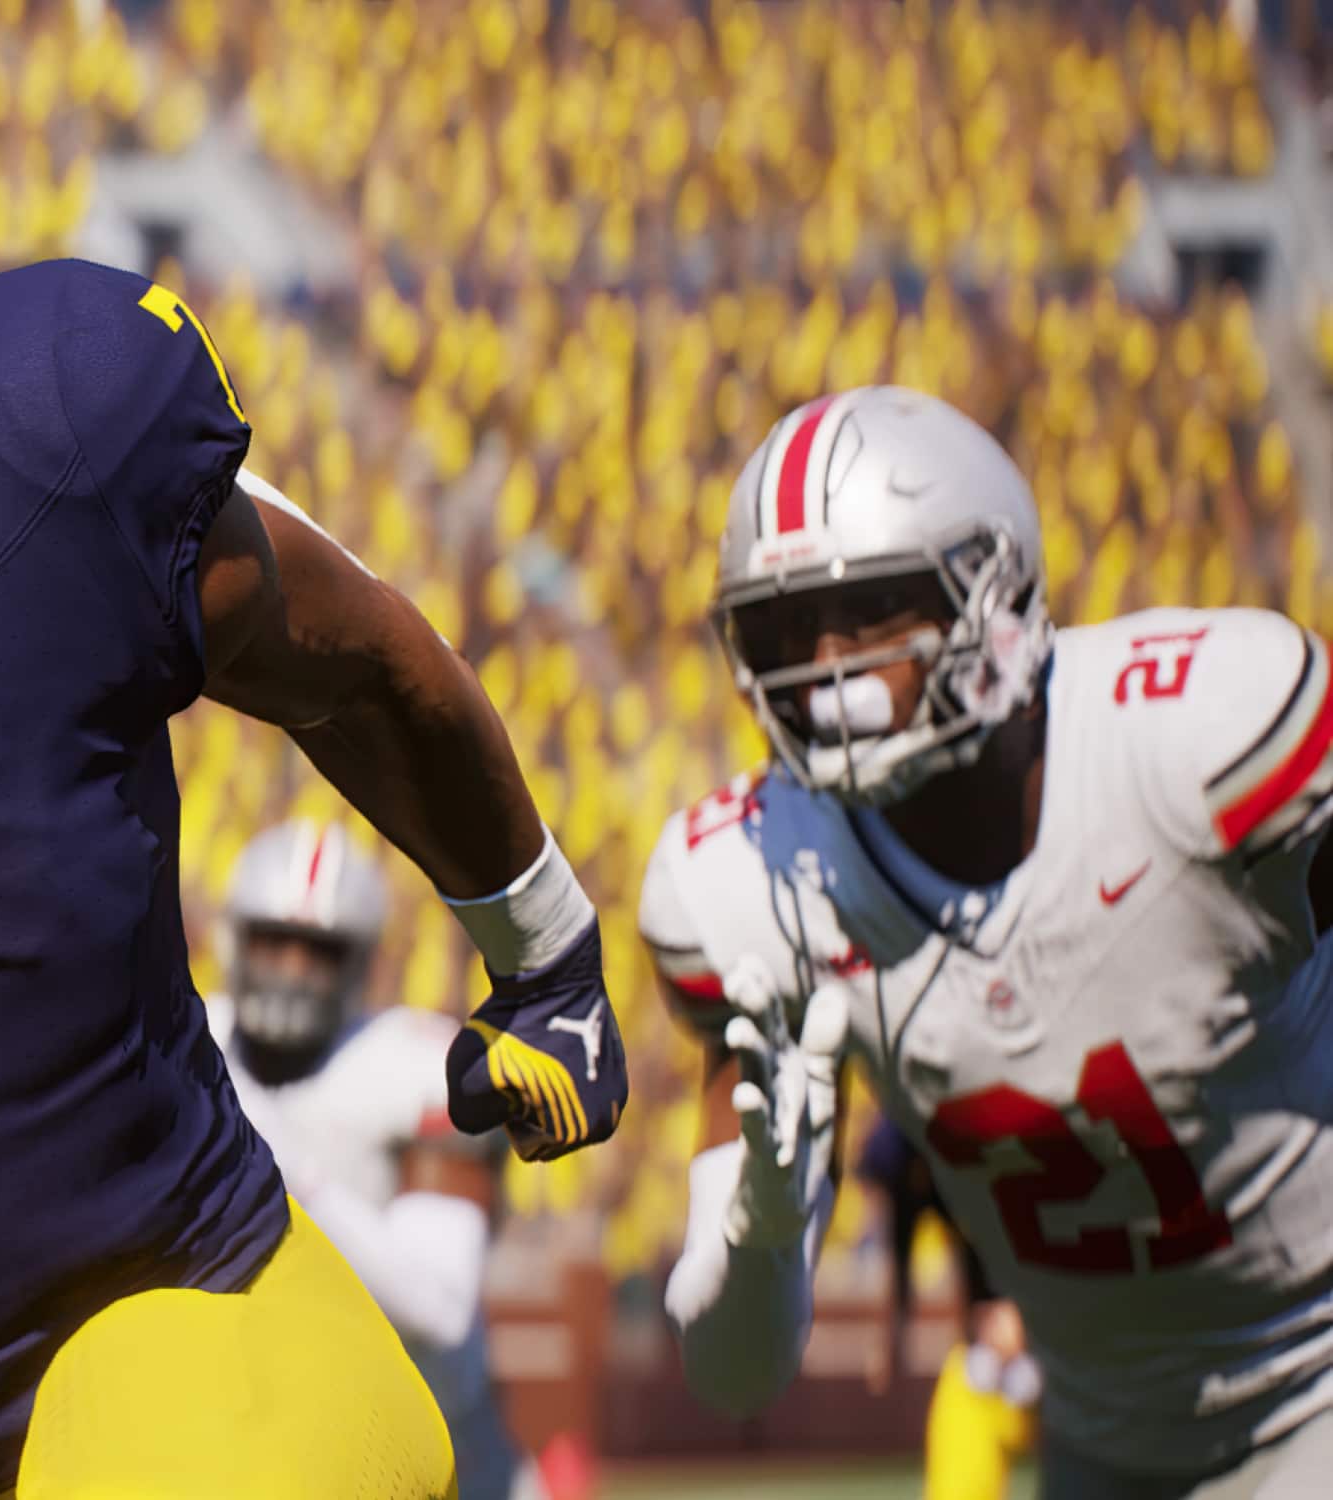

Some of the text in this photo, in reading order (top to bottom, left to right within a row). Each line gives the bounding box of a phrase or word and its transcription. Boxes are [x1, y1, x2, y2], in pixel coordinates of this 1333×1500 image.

[138, 284, 246, 423] 7
[1114, 627, 1208, 705] 21
[926, 1039, 1233, 1275] 21
